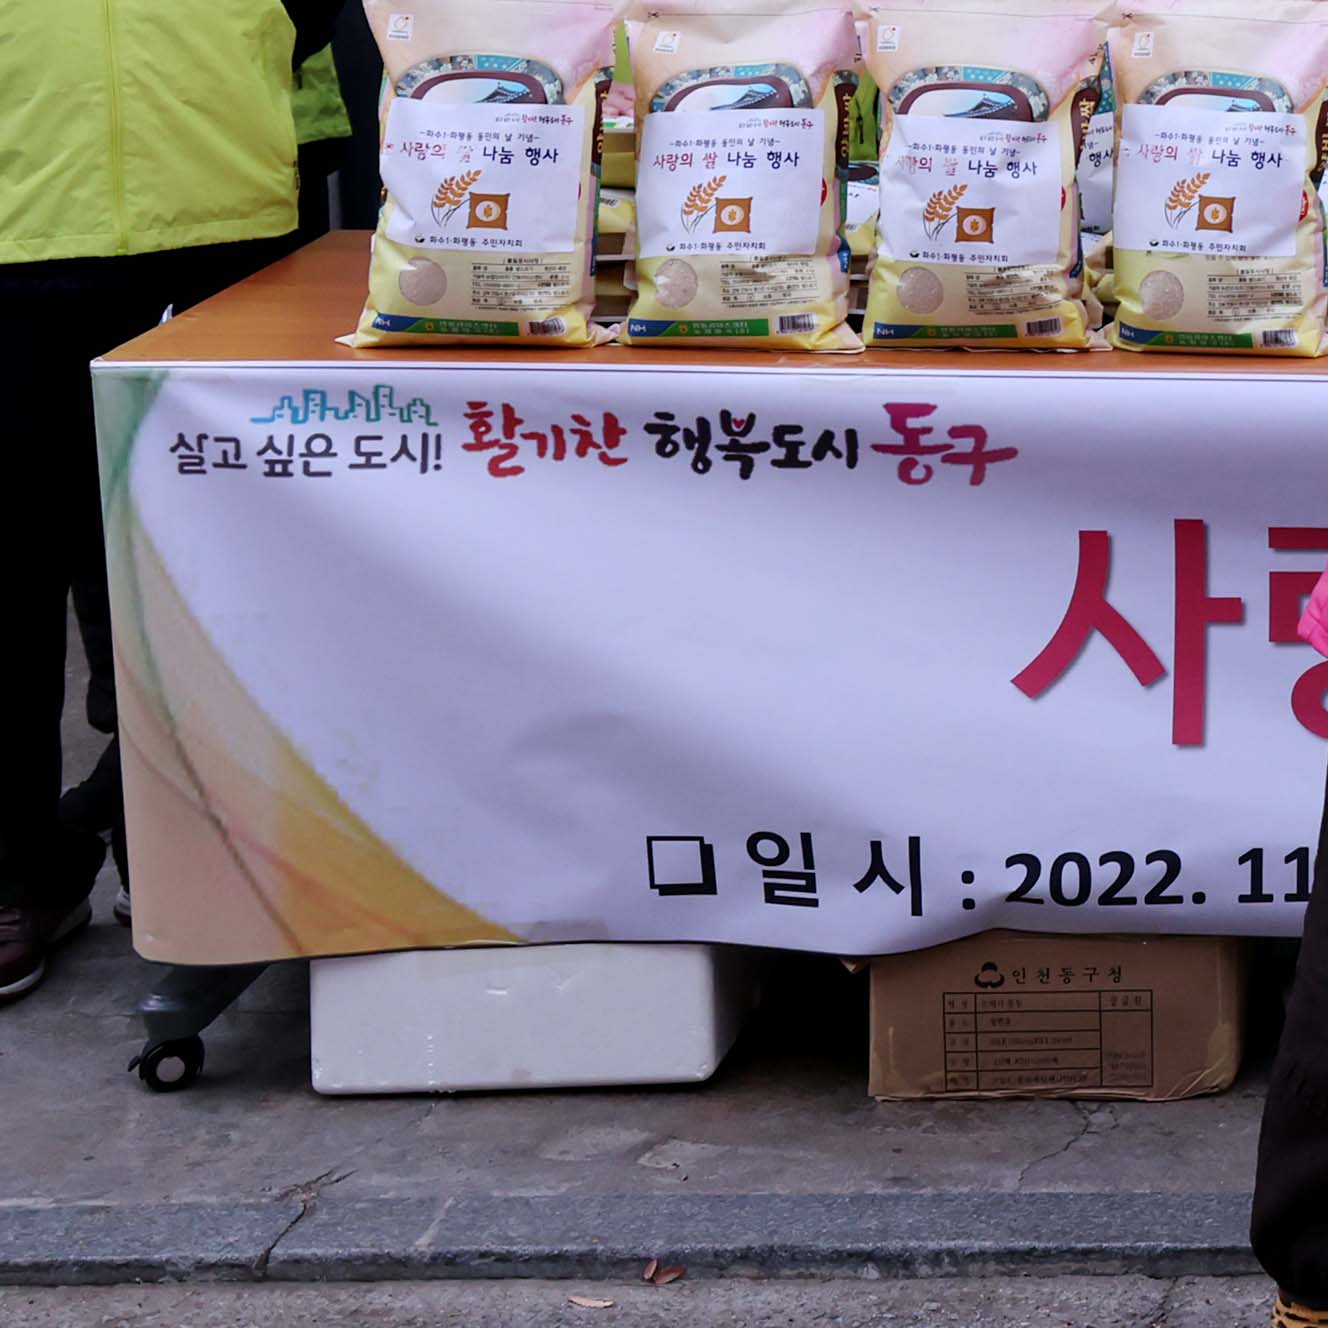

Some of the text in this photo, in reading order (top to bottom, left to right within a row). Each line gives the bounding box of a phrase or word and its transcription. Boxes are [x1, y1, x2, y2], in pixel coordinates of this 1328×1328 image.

[483, 146, 514, 165] 나눔
[525, 146, 559, 166] 행사
[652, 153, 693, 172] 사랑의
[727, 152, 757, 169] 나눔
[766, 151, 800, 170] 행사
[1212, 150, 1242, 168] 나눔
[1251, 151, 1283, 170] 행사
[968, 159, 999, 178] 나눔
[1006, 160, 1037, 179] 행사
[170, 400, 1019, 486] 살고 싶은 도시! 활기찬 행복도시 동구
[1005, 849, 1207, 908] 2022.
